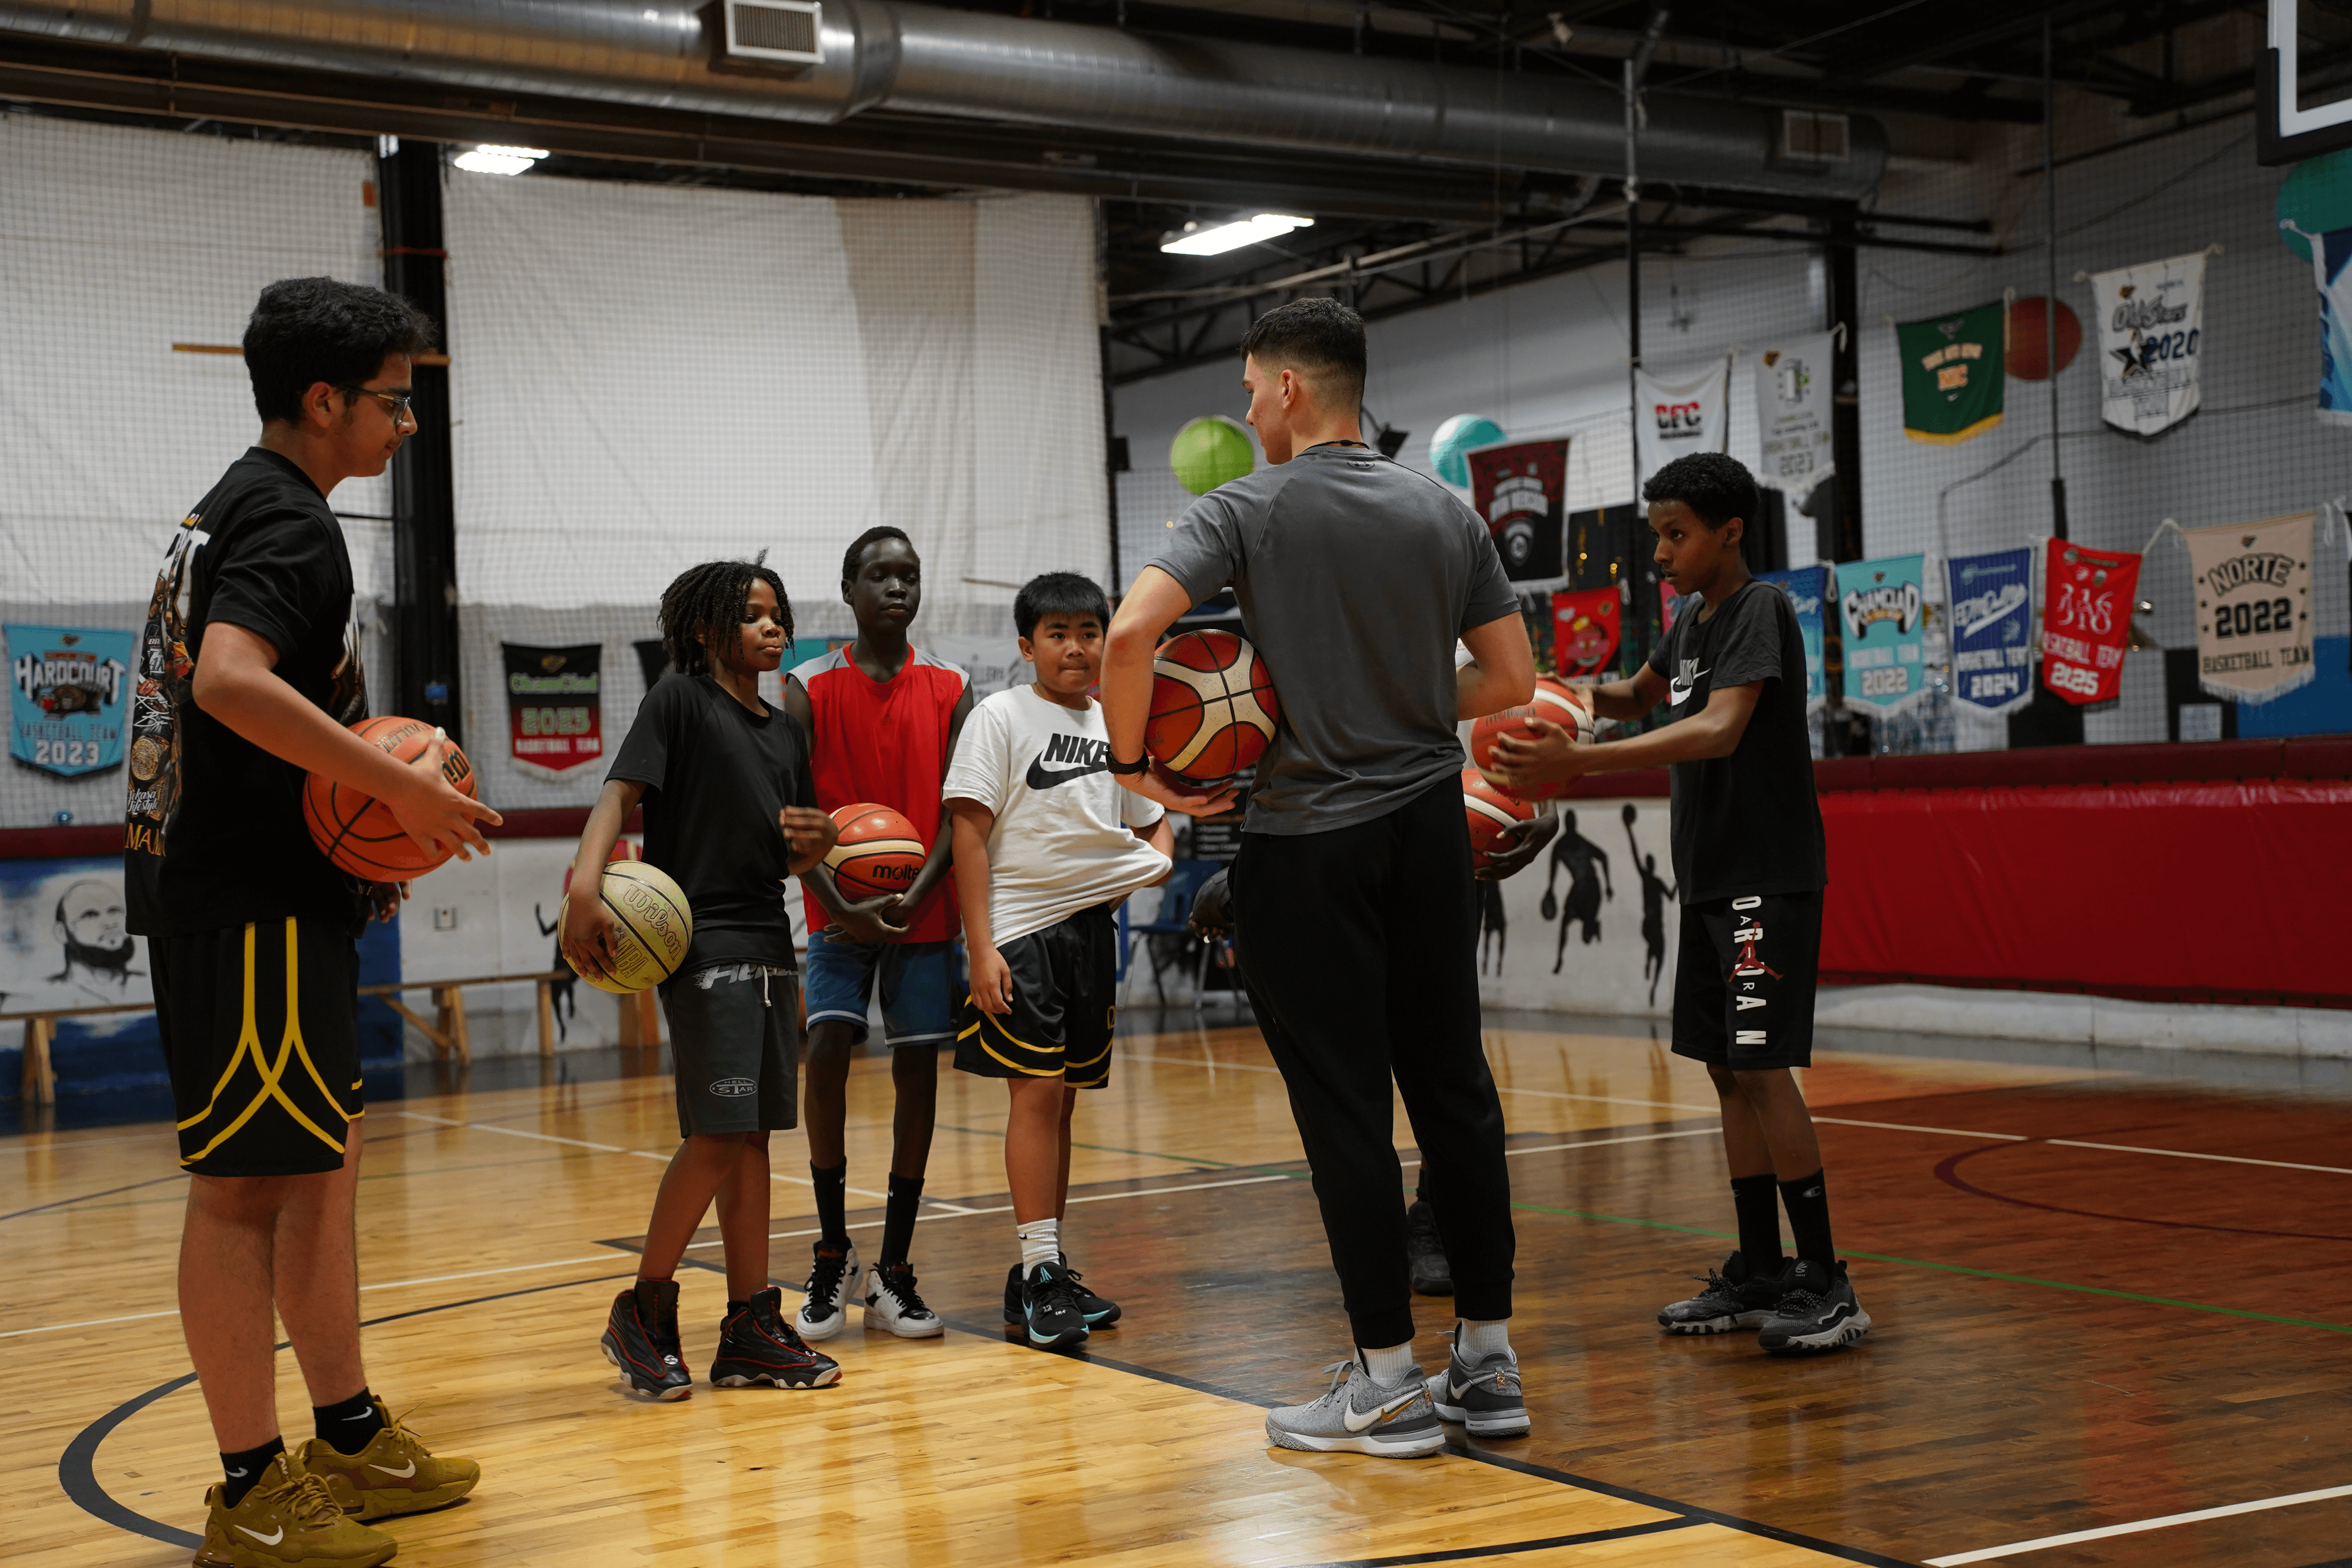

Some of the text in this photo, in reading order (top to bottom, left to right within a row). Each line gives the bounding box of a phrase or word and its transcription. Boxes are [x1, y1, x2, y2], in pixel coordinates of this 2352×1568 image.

[2144, 328, 2199, 363] 2020
[2207, 552, 2294, 597] NORTE
[2215, 598, 2292, 639] 2022
[2203, 645, 2311, 674] BASKETBALL TEAM
[1861, 666, 1909, 697] 2022
[1970, 673, 2019, 698] 2024
[20, 721, 119, 740] BASKETBALL TEAM
[521, 707, 592, 736] 2023
[35, 741, 99, 766] 2023
[1043, 733, 1109, 766] NIKE
[872, 864, 919, 880] molte
[624, 884, 682, 961] Wilson
[614, 938, 649, 978] NBA
[717, 1084, 753, 1095] STAR
